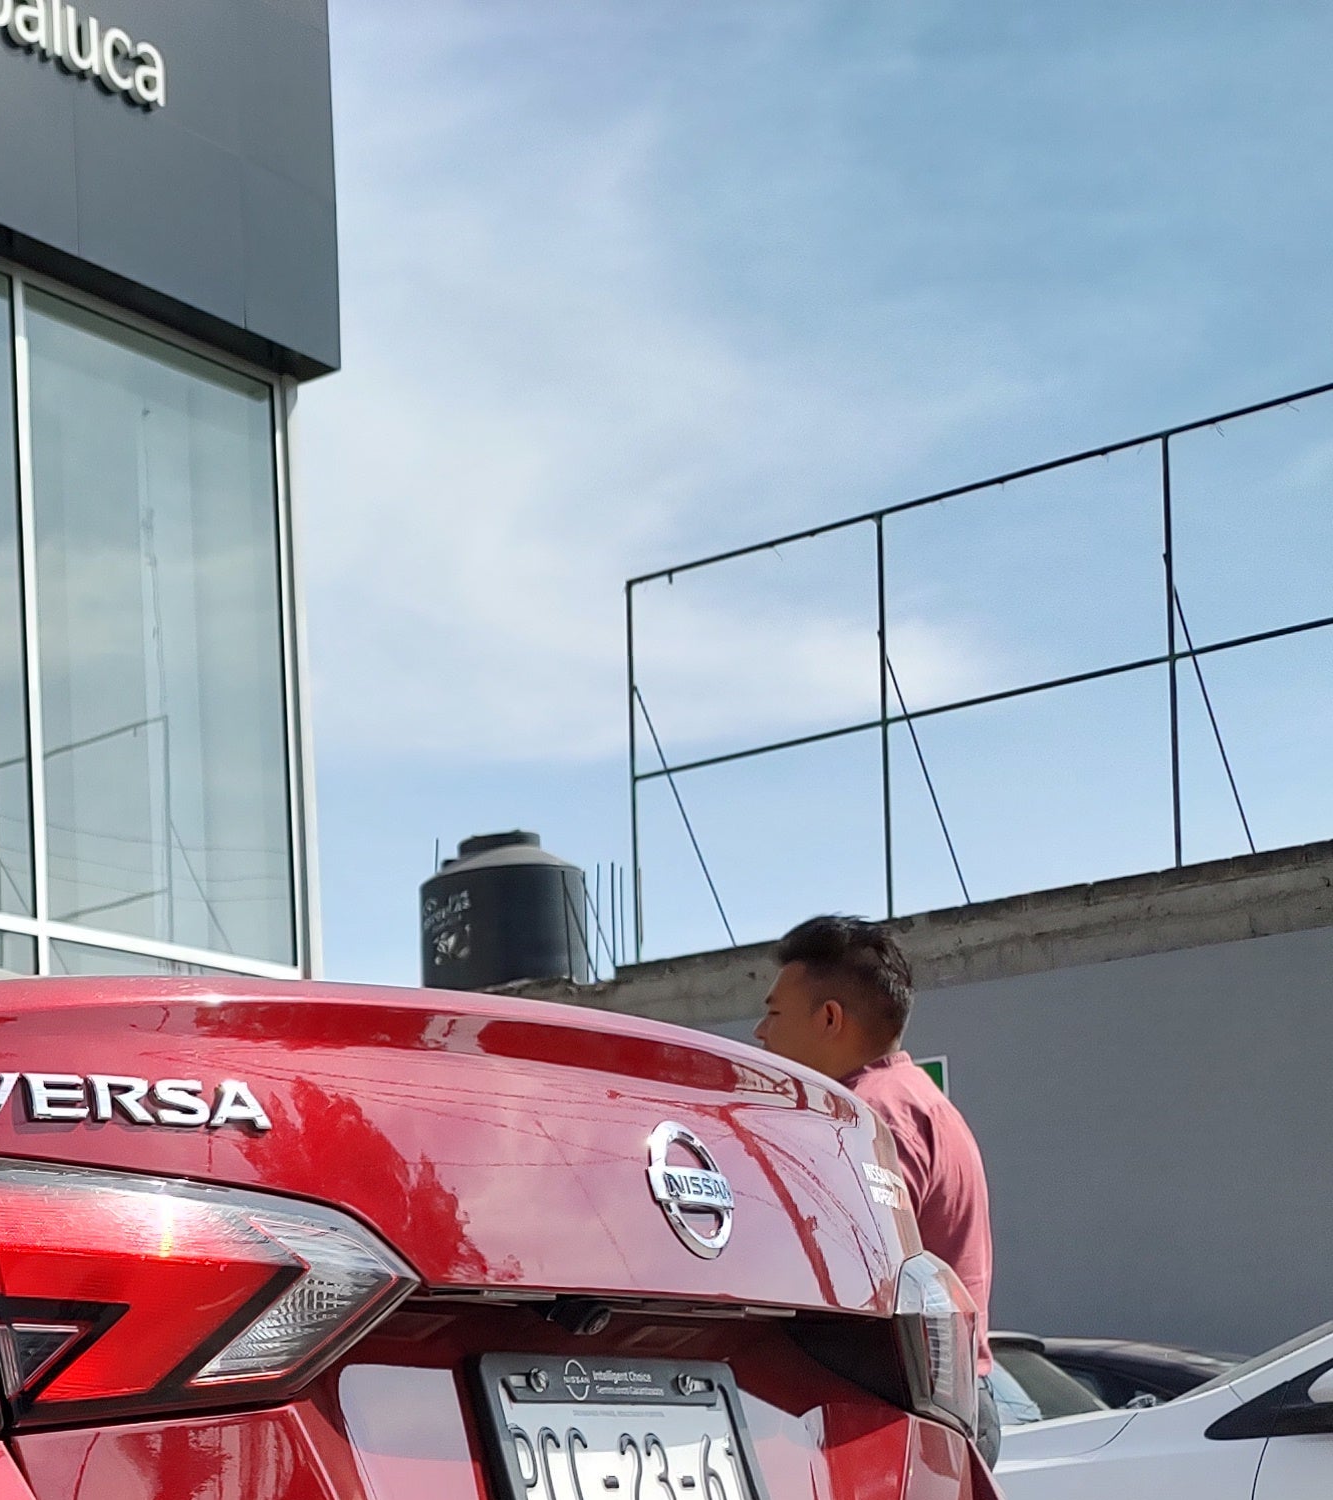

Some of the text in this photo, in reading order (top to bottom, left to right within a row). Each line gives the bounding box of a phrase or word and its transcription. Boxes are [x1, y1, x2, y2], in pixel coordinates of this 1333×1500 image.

[664, 1172, 732, 1200] NISSAN
[592, 1370, 652, 1384] Intelligent Choice
